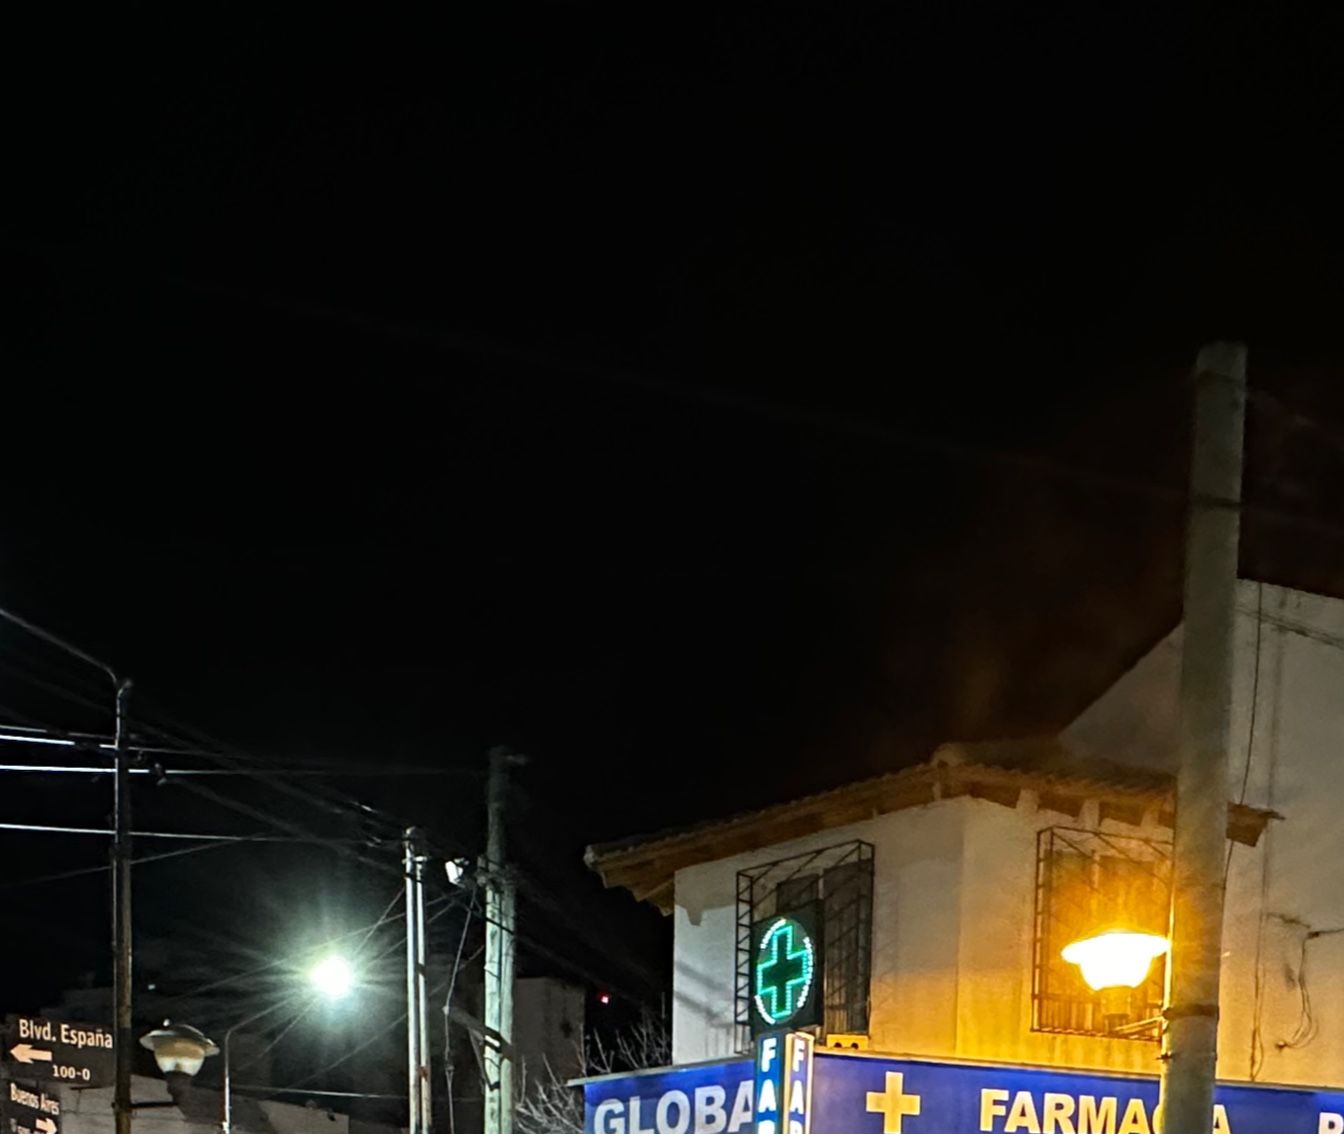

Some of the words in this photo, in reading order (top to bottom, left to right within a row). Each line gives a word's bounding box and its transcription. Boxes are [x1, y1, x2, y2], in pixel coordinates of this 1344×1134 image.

[19, 1019, 56, 1041] Blvd.
[60, 1024, 113, 1049] España
[53, 1065, 90, 1080] 100-0
